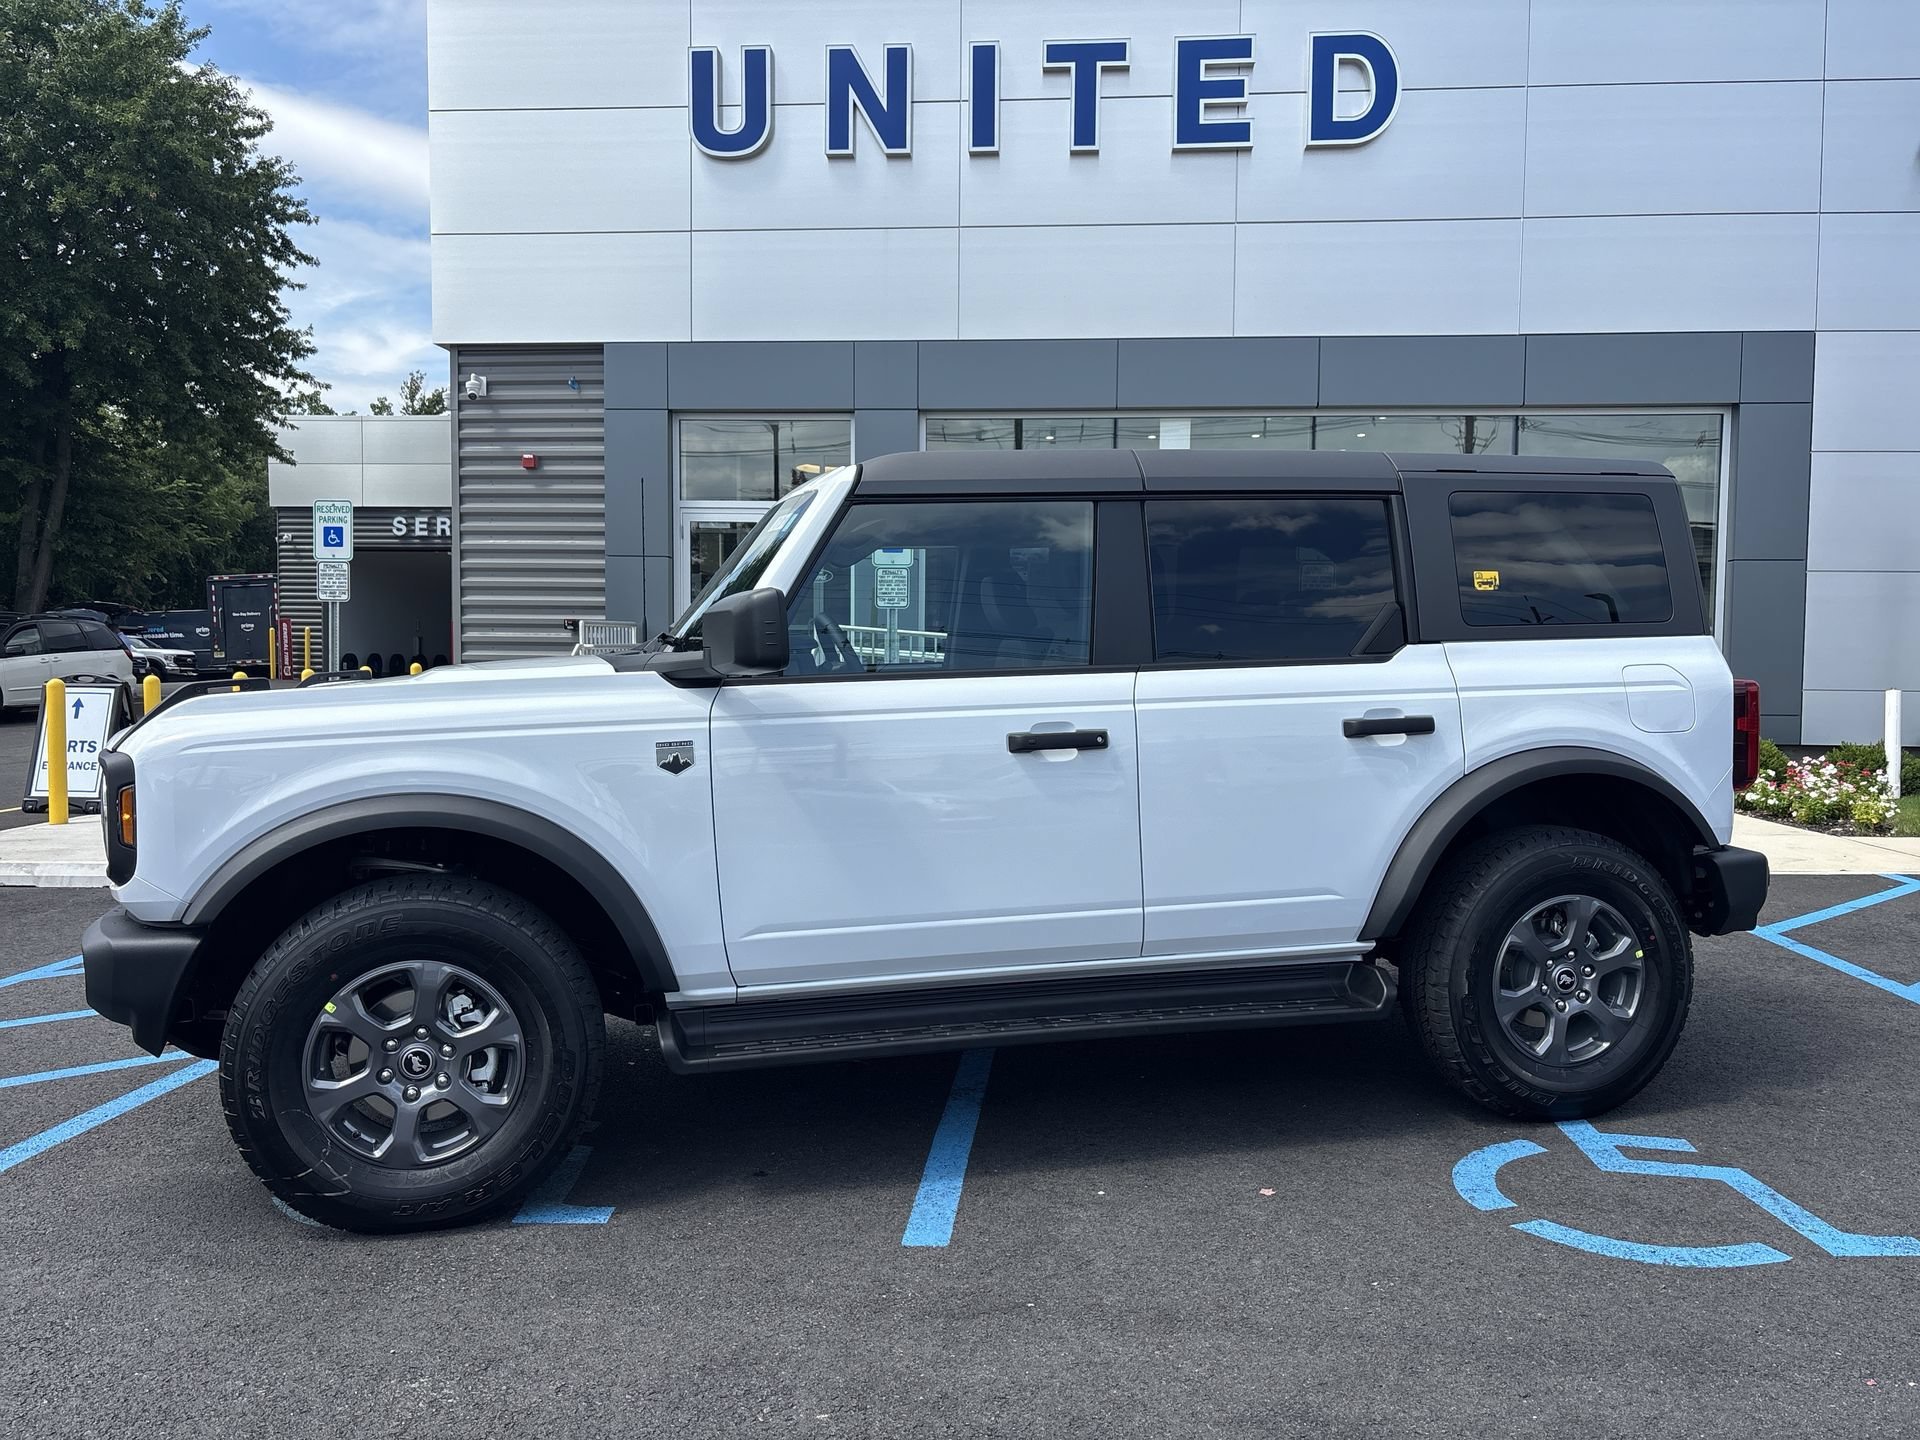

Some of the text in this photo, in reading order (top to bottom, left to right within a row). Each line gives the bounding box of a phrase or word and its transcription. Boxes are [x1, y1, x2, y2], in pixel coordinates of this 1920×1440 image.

[688, 30, 1403, 158] UNITED
[317, 505, 350, 514] RESERVED
[392, 516, 451, 536] SER
[67, 740, 98, 752] RTS
[42, 761, 98, 770] EANCE
[247, 912, 404, 1121] BRIDGESTONE
